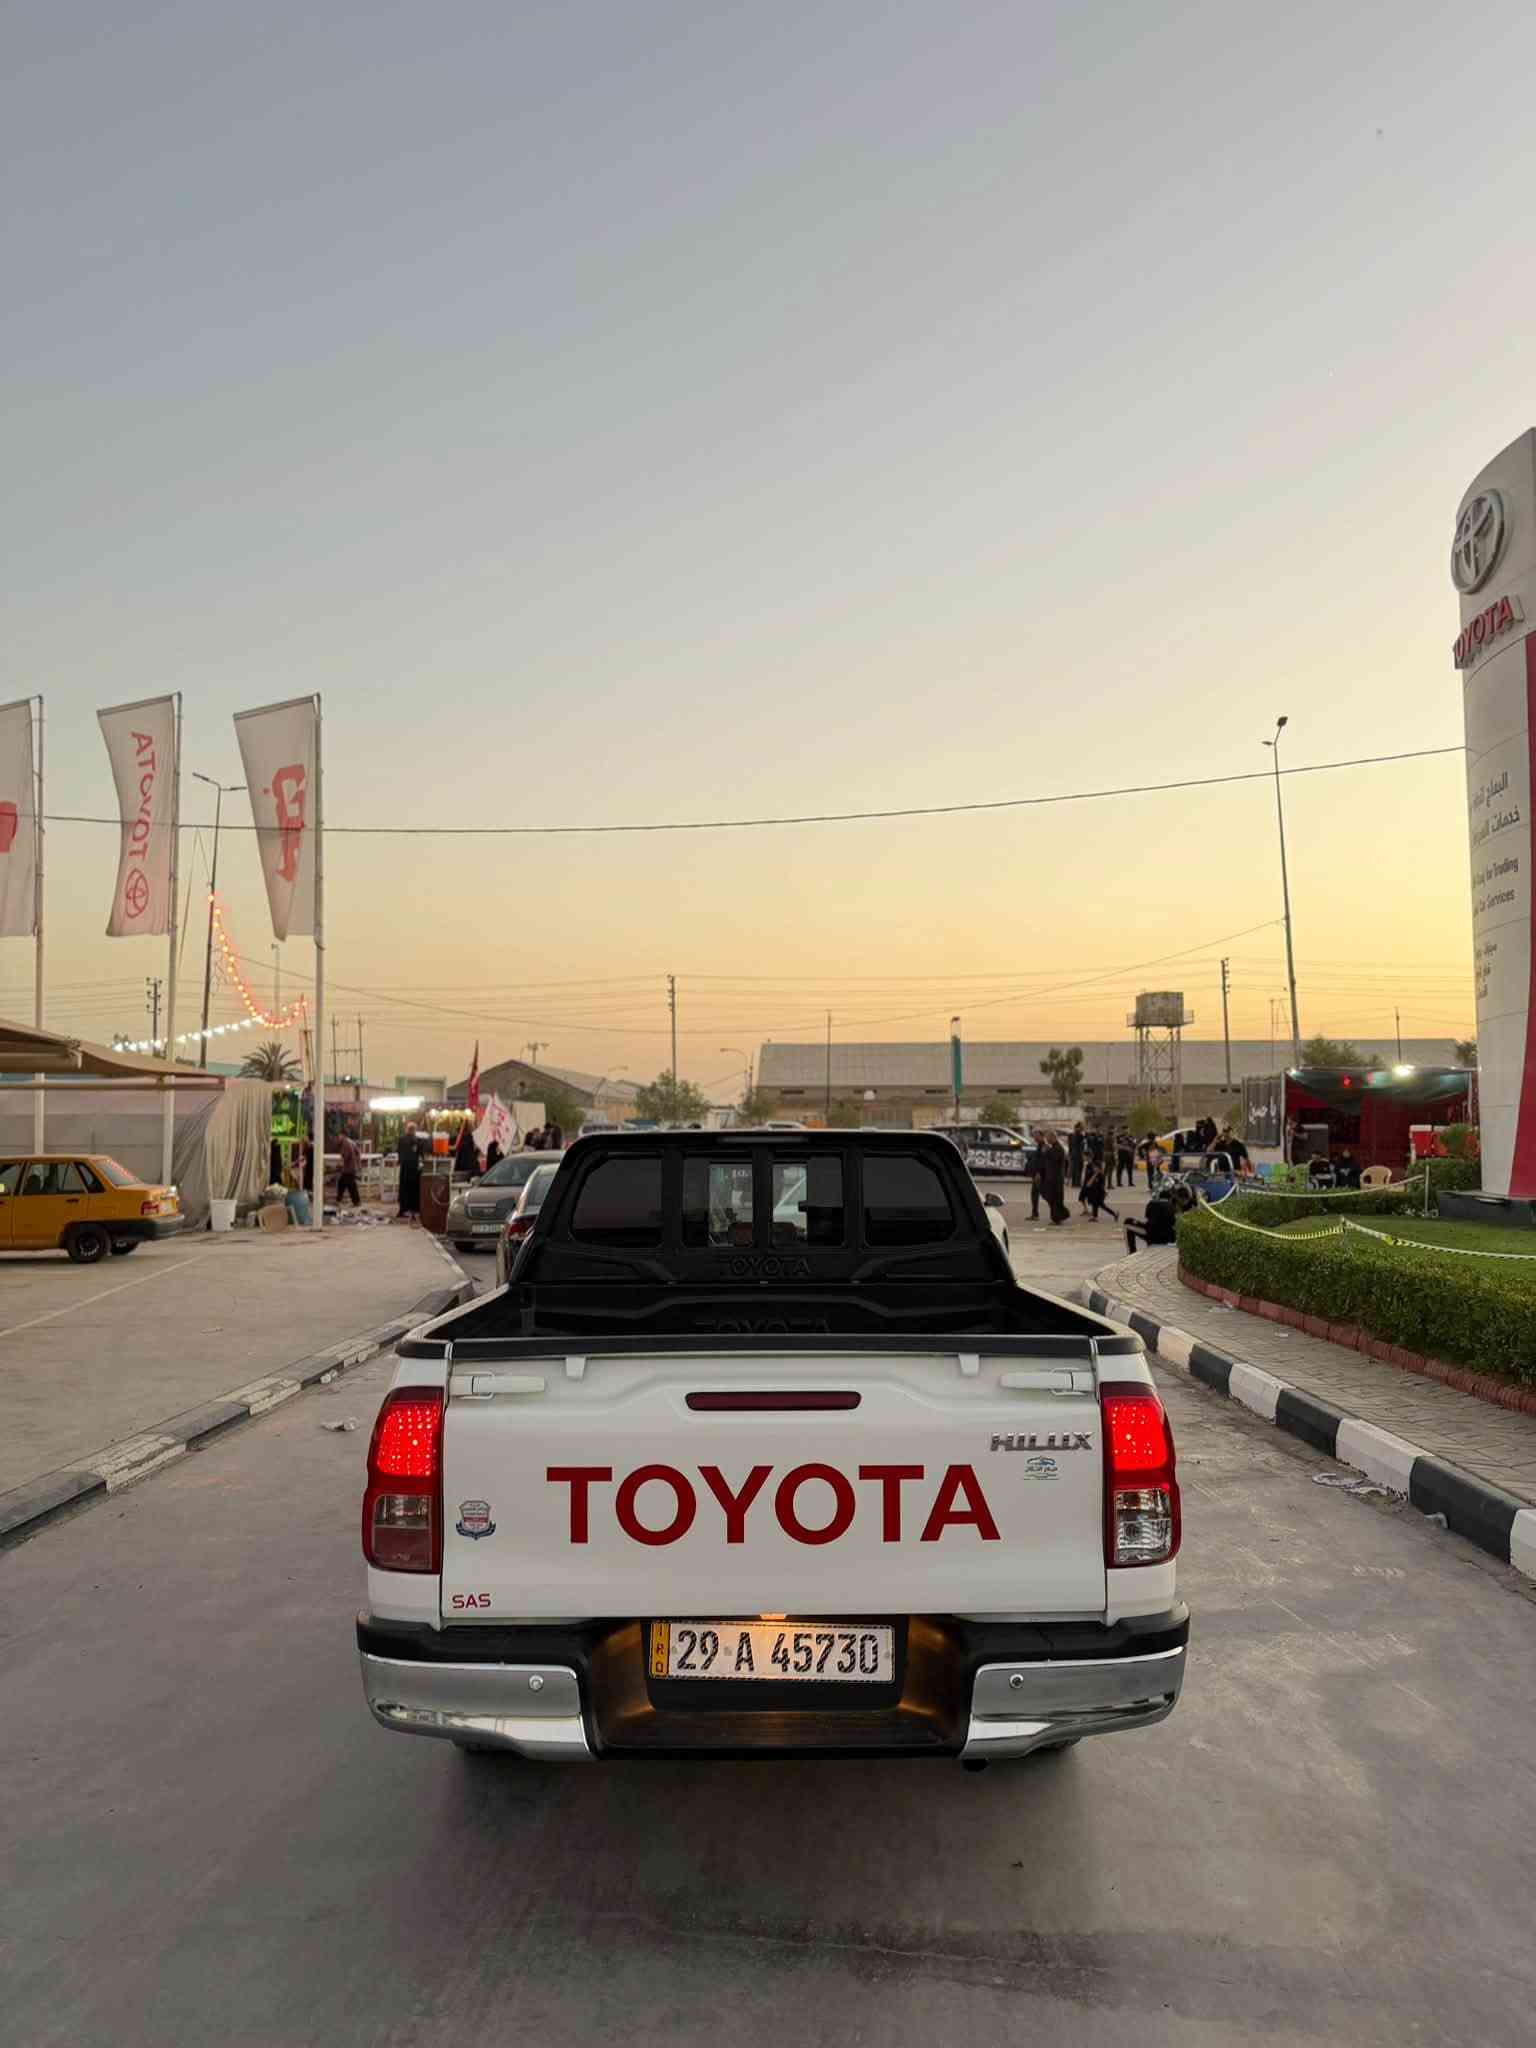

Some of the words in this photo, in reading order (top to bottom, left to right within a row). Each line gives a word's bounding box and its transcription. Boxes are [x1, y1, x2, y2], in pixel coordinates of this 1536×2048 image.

[1455, 595, 1515, 664] OYOTA
[965, 1150, 1022, 1168] POLICE
[990, 1431, 1093, 1451] HILUX
[546, 1463, 1001, 1545] TOYOTA
[452, 1593, 491, 1608] SAS
[677, 1630, 719, 1670] 29
[734, 1631, 754, 1672] A
[771, 1632, 879, 1674] 45730
